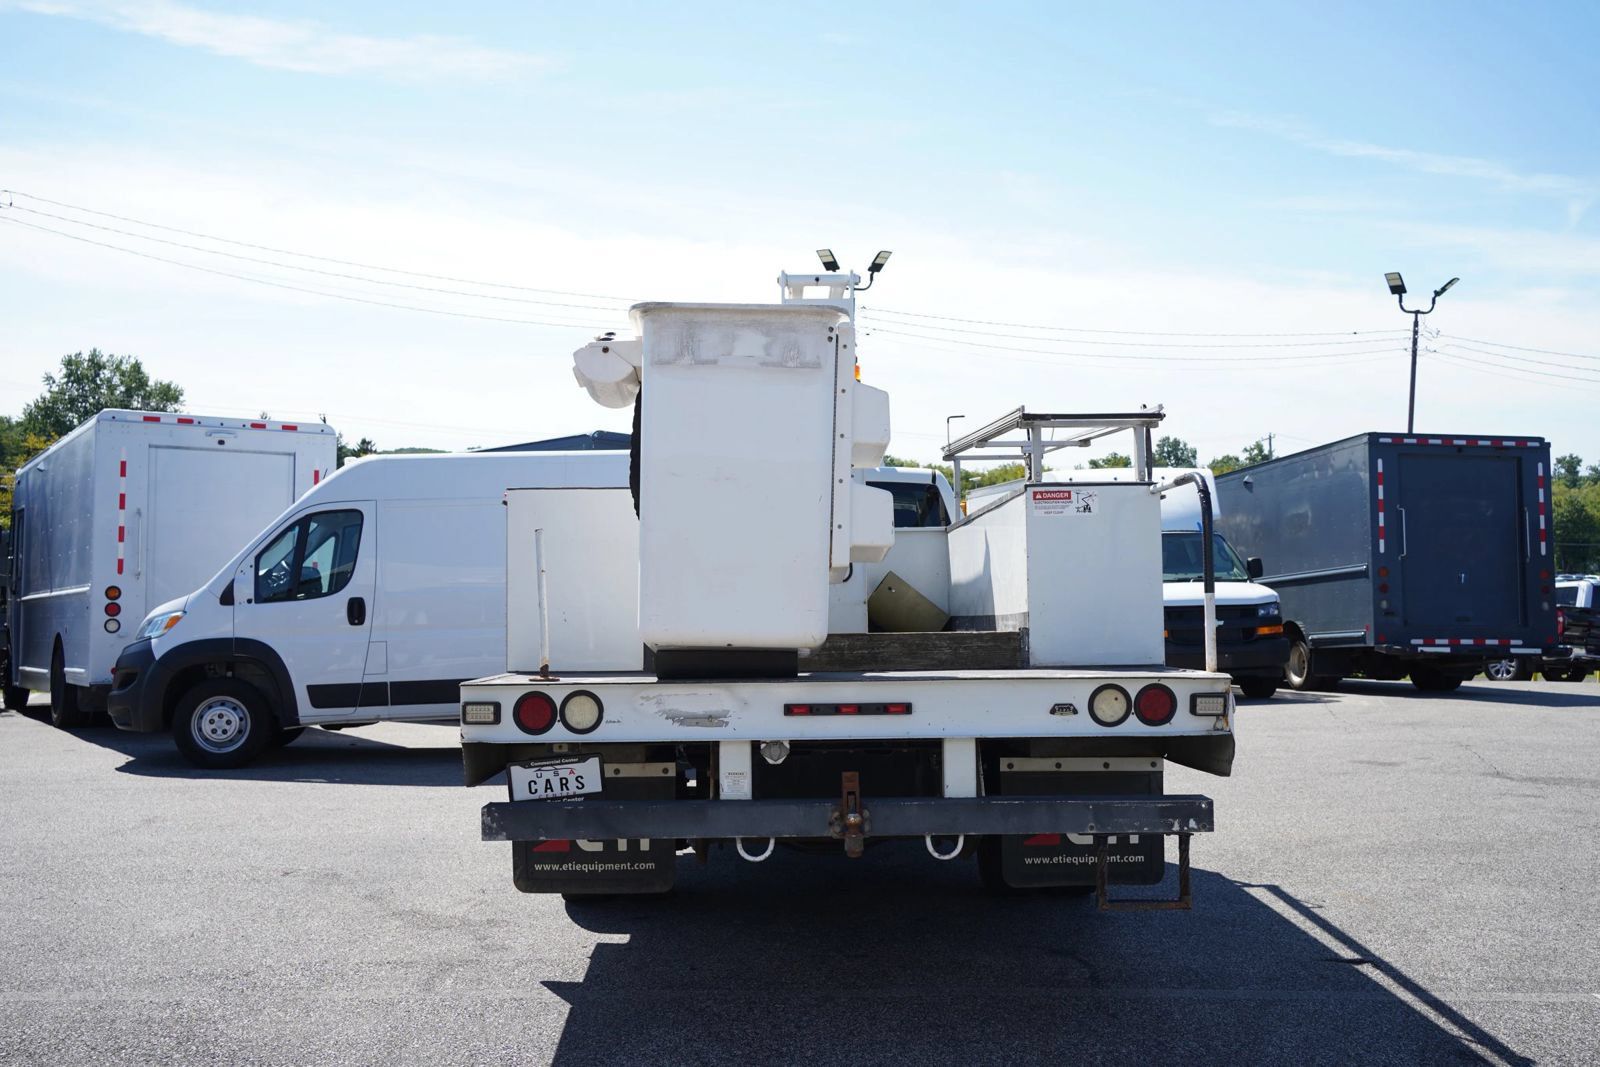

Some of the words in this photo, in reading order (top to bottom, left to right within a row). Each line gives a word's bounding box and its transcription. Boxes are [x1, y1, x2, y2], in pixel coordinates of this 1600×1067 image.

[528, 775, 585, 795] CARS
[1024, 853, 1145, 865] www.etiequipent.com
[534, 862, 655, 872] www.etiequipment.com
